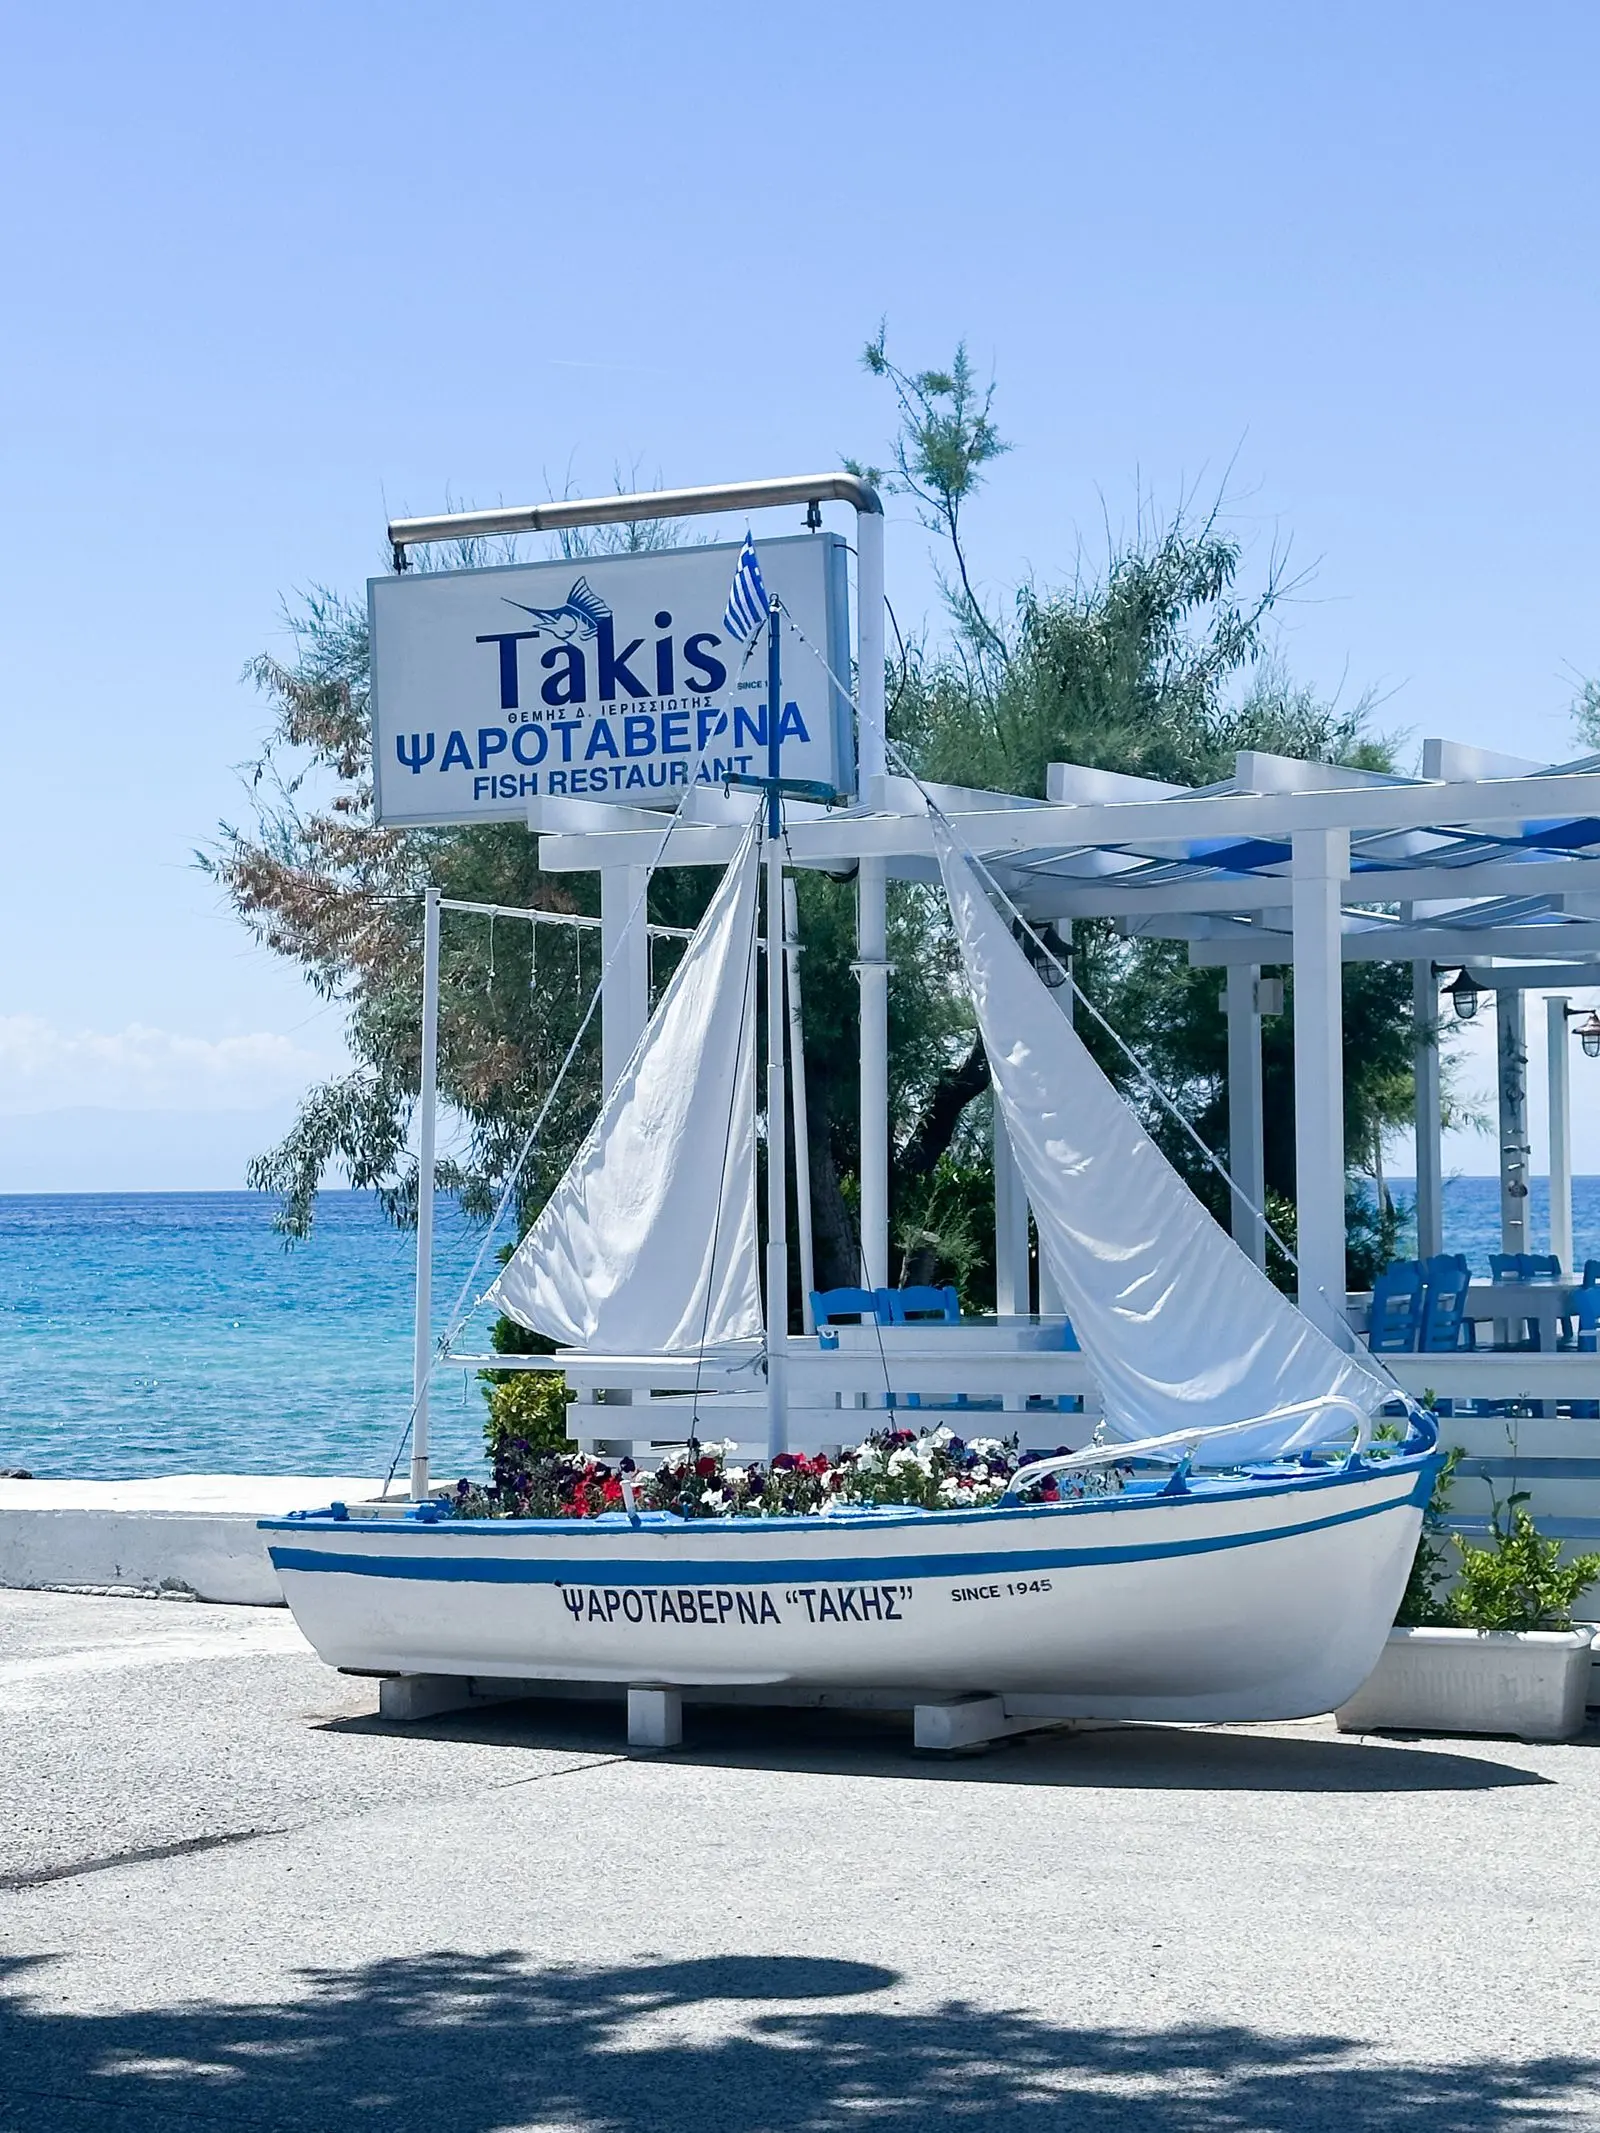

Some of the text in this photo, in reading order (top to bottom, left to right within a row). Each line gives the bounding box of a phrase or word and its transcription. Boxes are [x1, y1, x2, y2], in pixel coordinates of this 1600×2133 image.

[475, 611, 727, 710] Takis
[737, 680, 762, 690] SINCE
[508, 709, 566, 724] ΘΕΜΗΣ
[601, 696, 713, 716] ΙΕΡΙΣΣΙΩΤΗΣ
[396, 701, 811, 775] ΨΑΡΟΤΑΒΕΡΝΑ
[473, 755, 753, 801] FISH RESTAURANT
[561, 1588, 781, 1625] ΨΑΡΟΤΑΒΕΡΝΑ
[951, 1578, 1053, 1603] SINCE 1945
